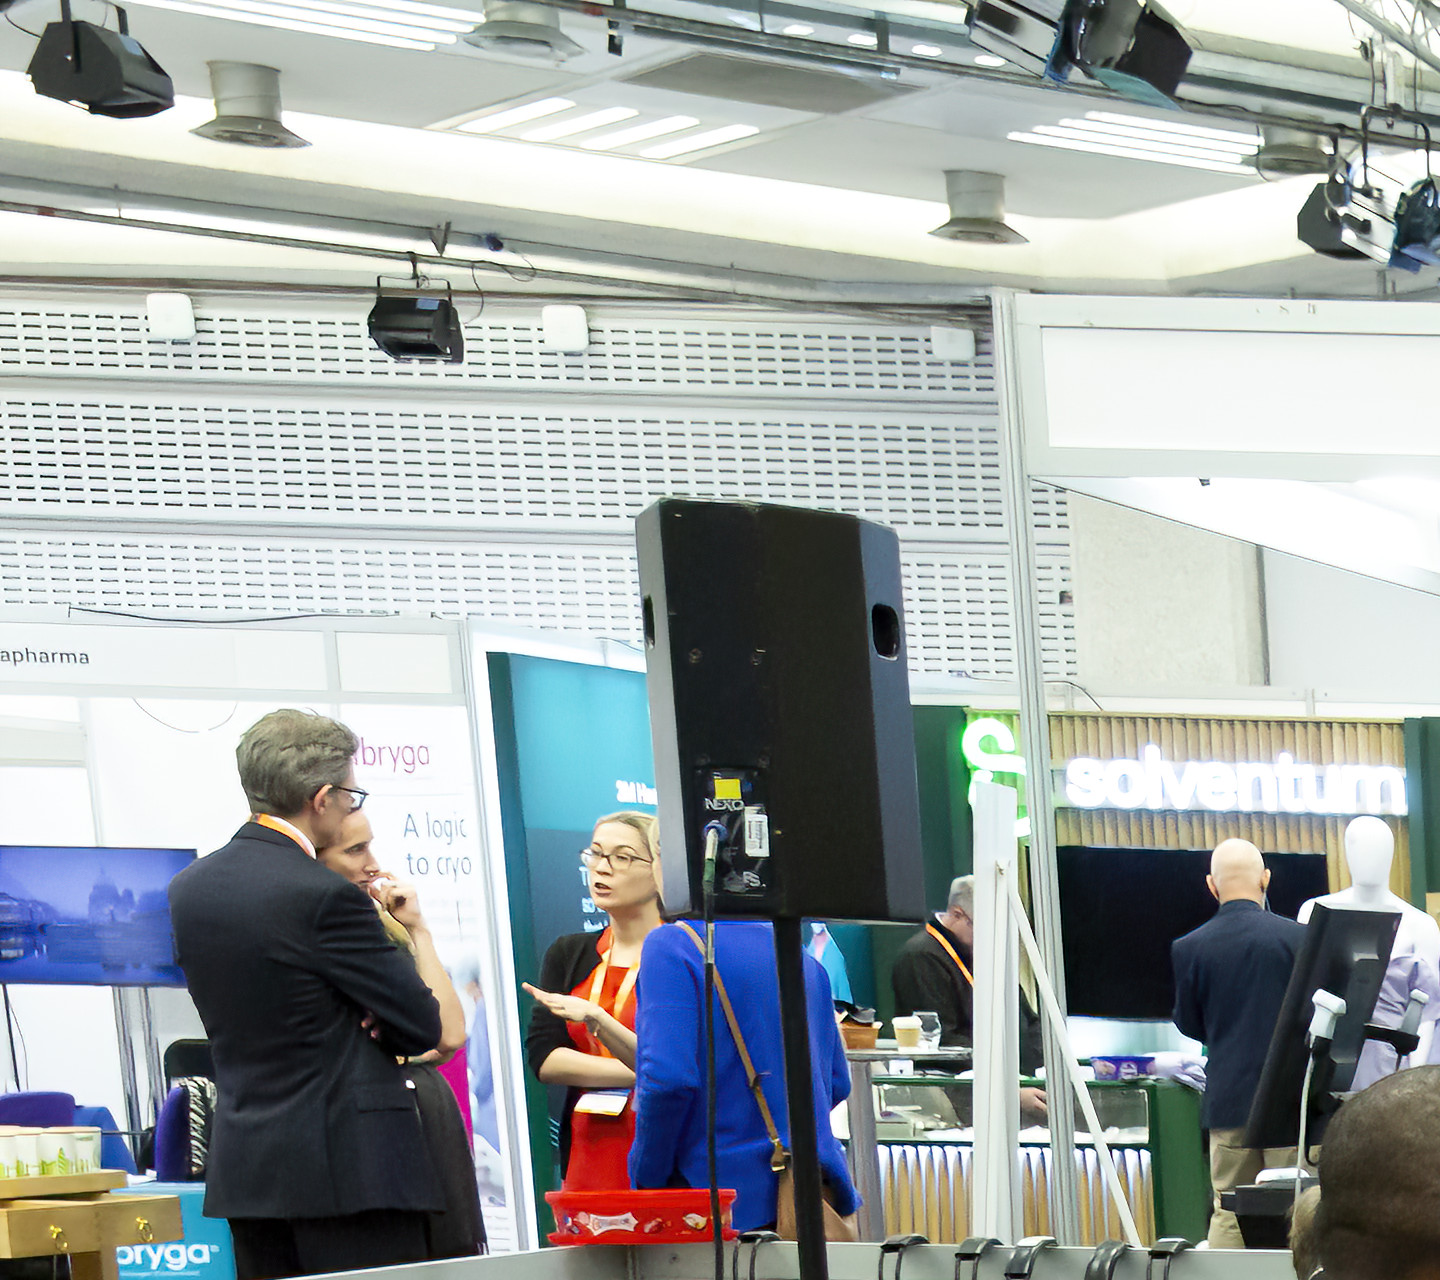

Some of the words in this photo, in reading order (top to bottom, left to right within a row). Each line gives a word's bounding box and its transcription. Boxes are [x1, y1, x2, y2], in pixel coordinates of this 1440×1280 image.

[353, 736, 430, 773] bryga
[1065, 744, 1407, 816] solventum
[704, 797, 745, 812] NEXO
[403, 813, 419, 838] A
[406, 852, 429, 875] to
[436, 855, 472, 883] cryo
